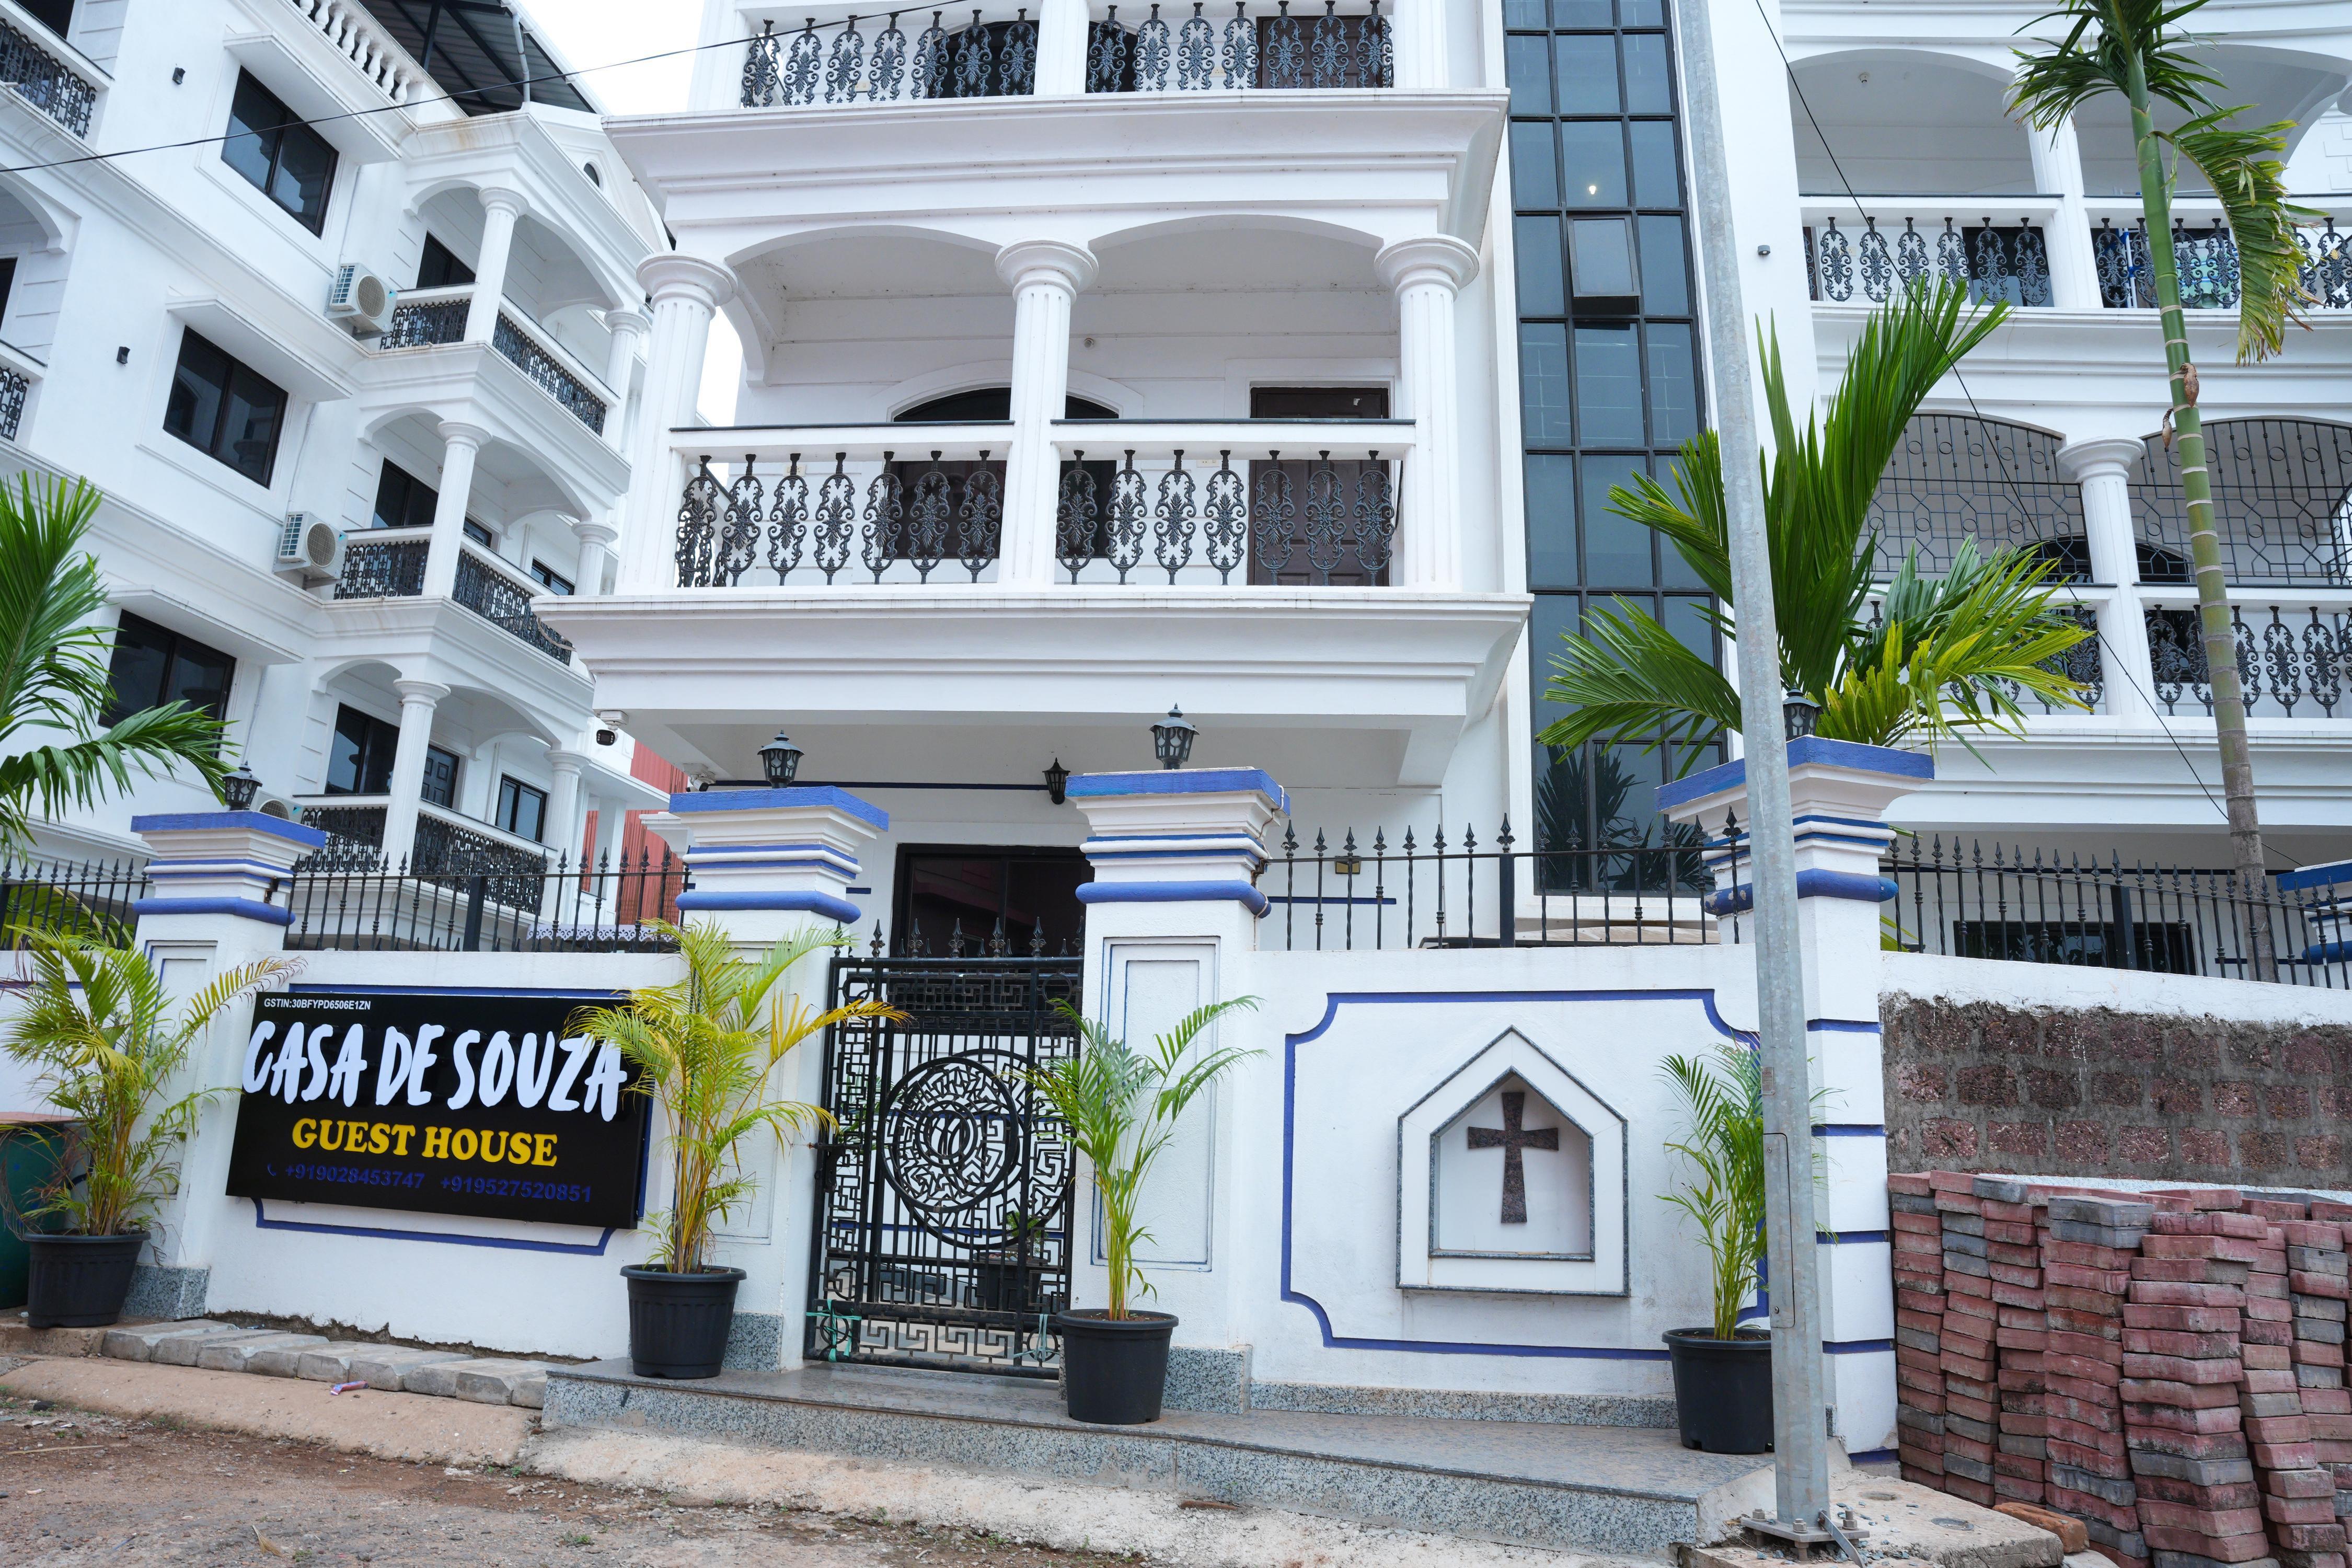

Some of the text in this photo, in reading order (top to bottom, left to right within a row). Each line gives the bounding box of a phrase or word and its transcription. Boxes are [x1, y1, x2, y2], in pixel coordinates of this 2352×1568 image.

[264, 998, 371, 1010] GSTIN:30BFYPD6506E1ZN
[243, 1021, 627, 1122] CASA DE SOUZA
[292, 1118, 558, 1167] GUEST HOUSE
[285, 1163, 591, 1202] +919028453747 +919527520851
